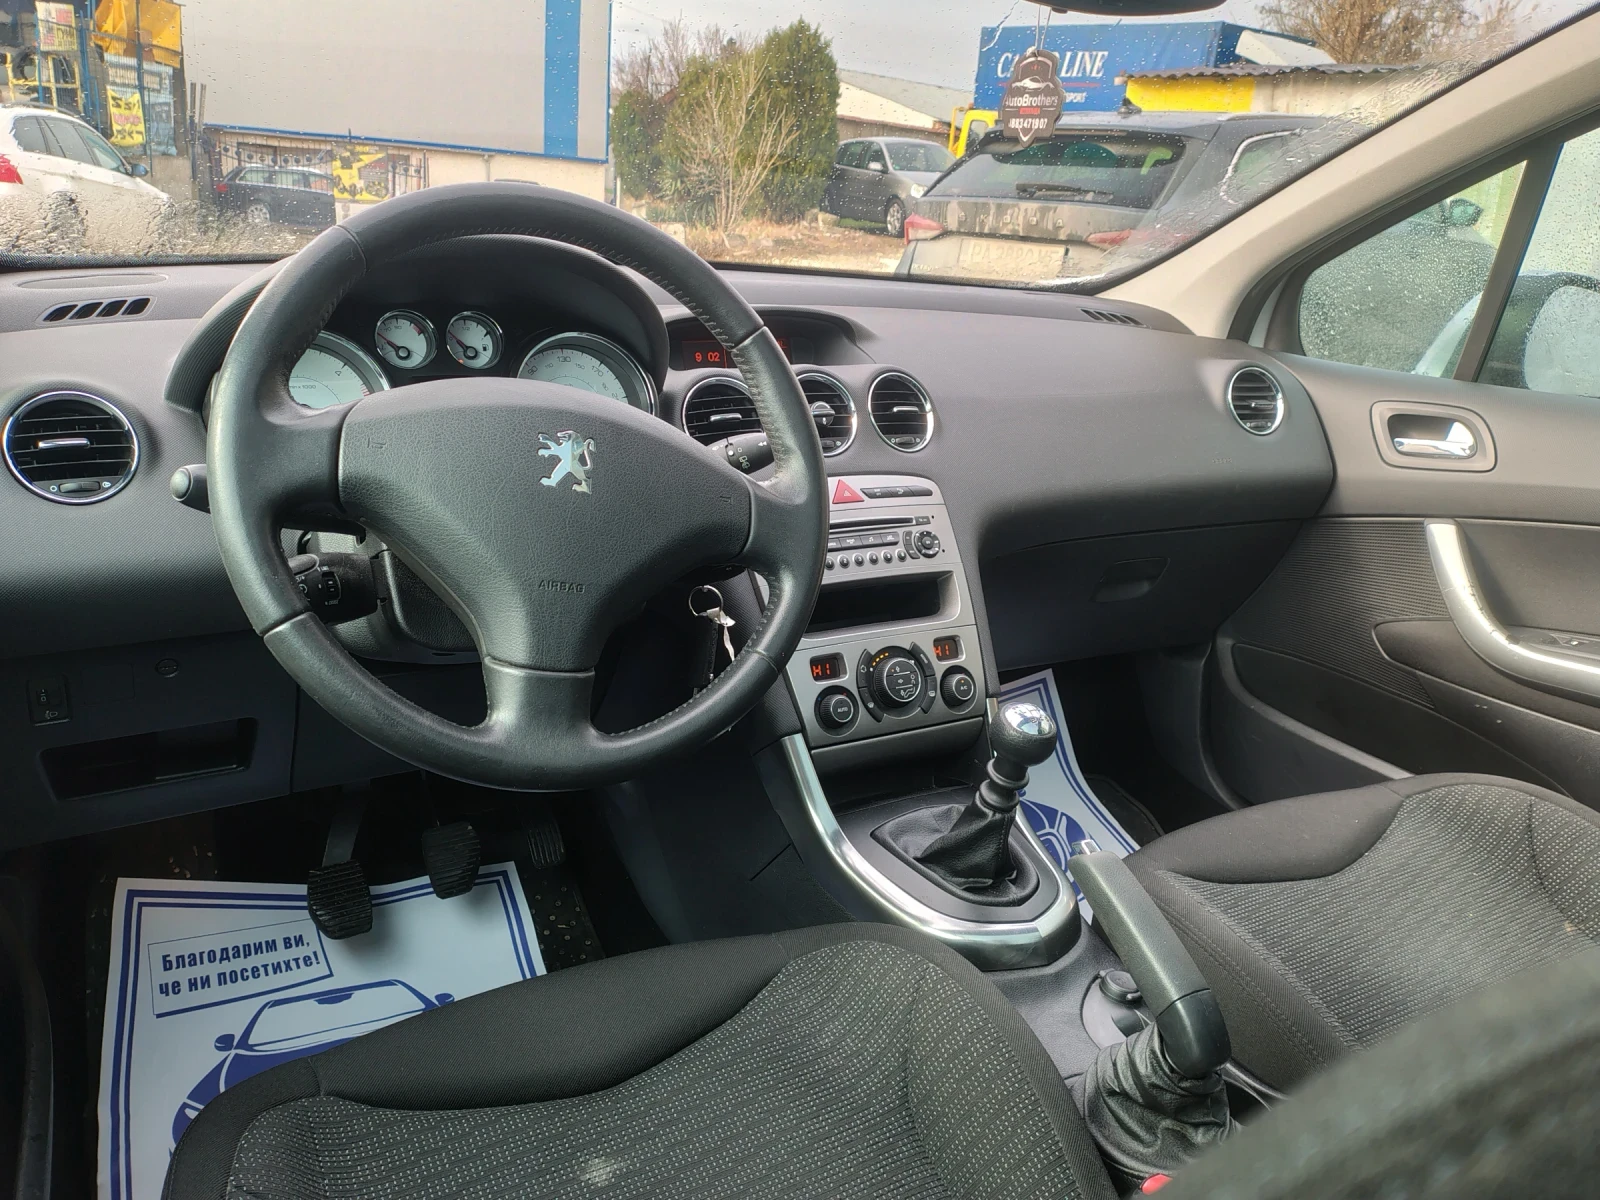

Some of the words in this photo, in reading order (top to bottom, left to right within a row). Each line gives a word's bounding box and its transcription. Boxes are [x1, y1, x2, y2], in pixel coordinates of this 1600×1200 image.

[1060, 50, 1109, 78] LINE
[556, 355, 572, 363] 130
[575, 362, 586, 370] 150
[528, 365, 539, 376] 90
[591, 365, 604, 378] 170
[538, 579, 586, 594] AIRBAG
[161, 938, 278, 972] Благодарим
[282, 934, 310, 950] ви,
[158, 980, 182, 997] че
[187, 974, 211, 993] ни
[217, 951, 321, 987] посетихте!
